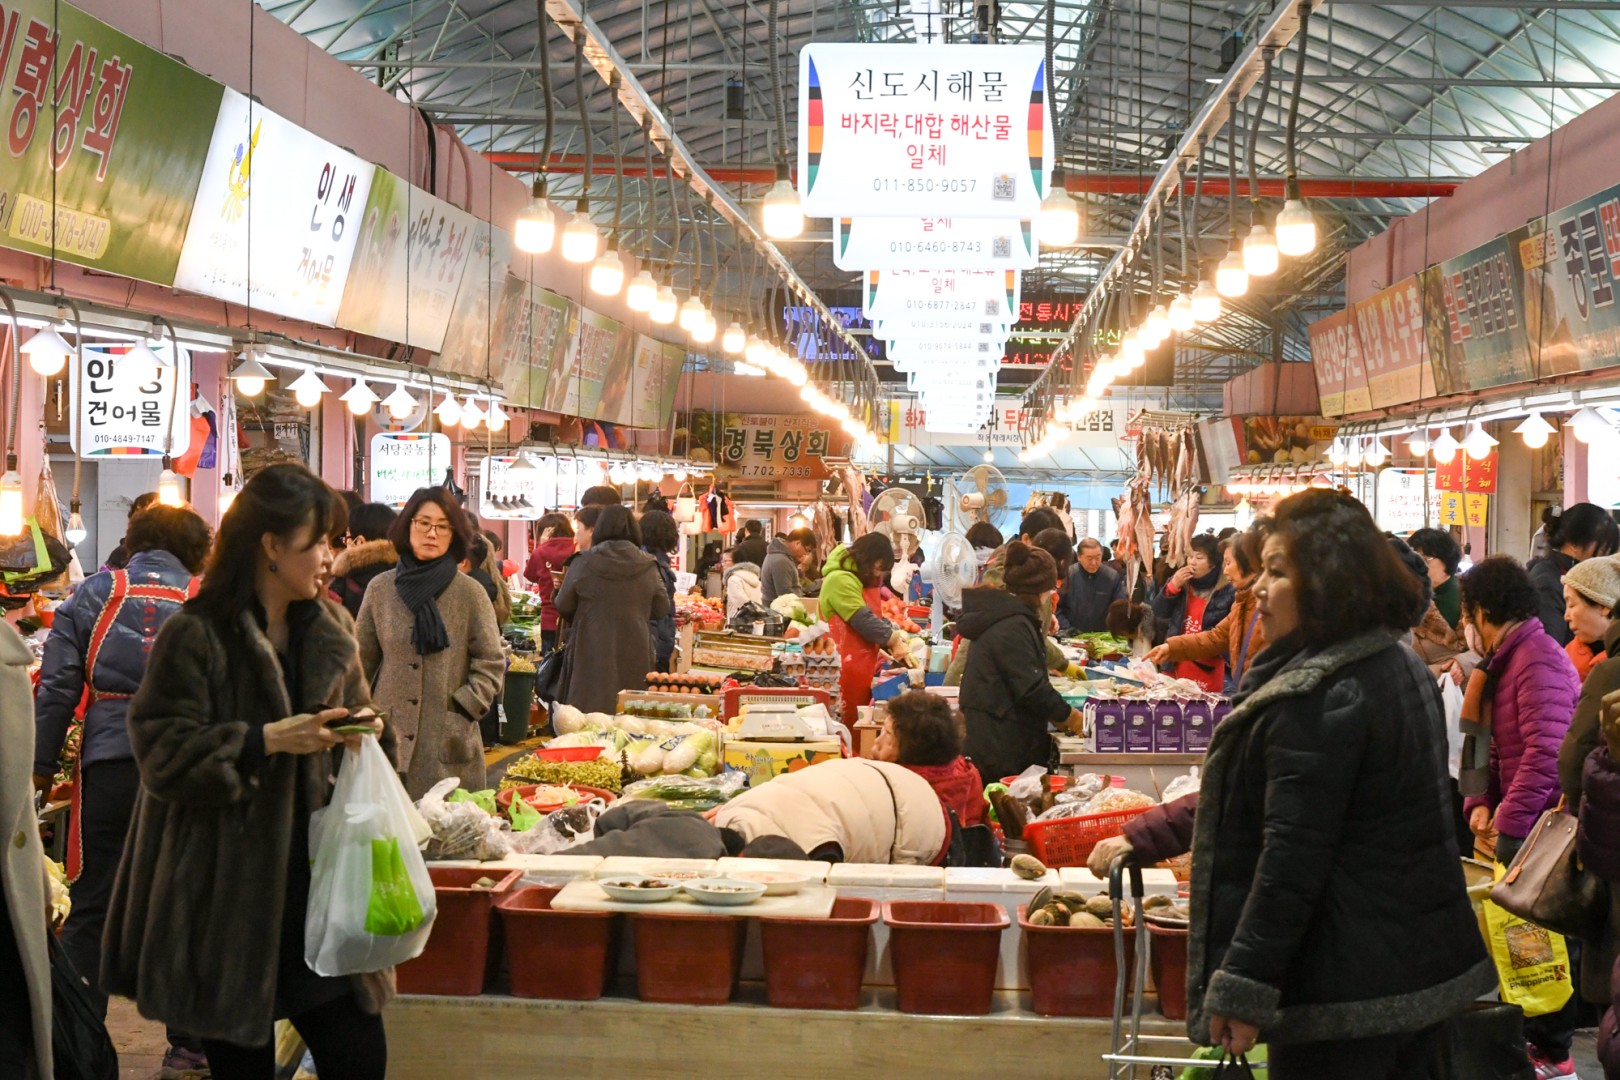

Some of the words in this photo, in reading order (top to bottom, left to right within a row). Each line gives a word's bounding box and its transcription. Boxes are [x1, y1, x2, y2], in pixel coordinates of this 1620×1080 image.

[848, 68, 1008, 102] 신도시해물
[841, 113, 944, 139] 바지락,대합
[950, 114, 1012, 140] 해산물
[906, 144, 947, 170] 일체
[873, 177, 977, 193] 011-850-9057
[310, 162, 357, 242] 인생
[890, 241, 982, 253] 010-6460-8743
[931, 278, 956, 294] 일체
[906, 300, 977, 310] 010-6877-2847
[88, 401, 161, 426] 건어물
[94, 434, 155, 443] 010-4849-7147
[724, 428, 831, 463] 경북상회
[741, 465, 811, 477] T.702-7336
[1510, 974, 1555, 990] Philippines
